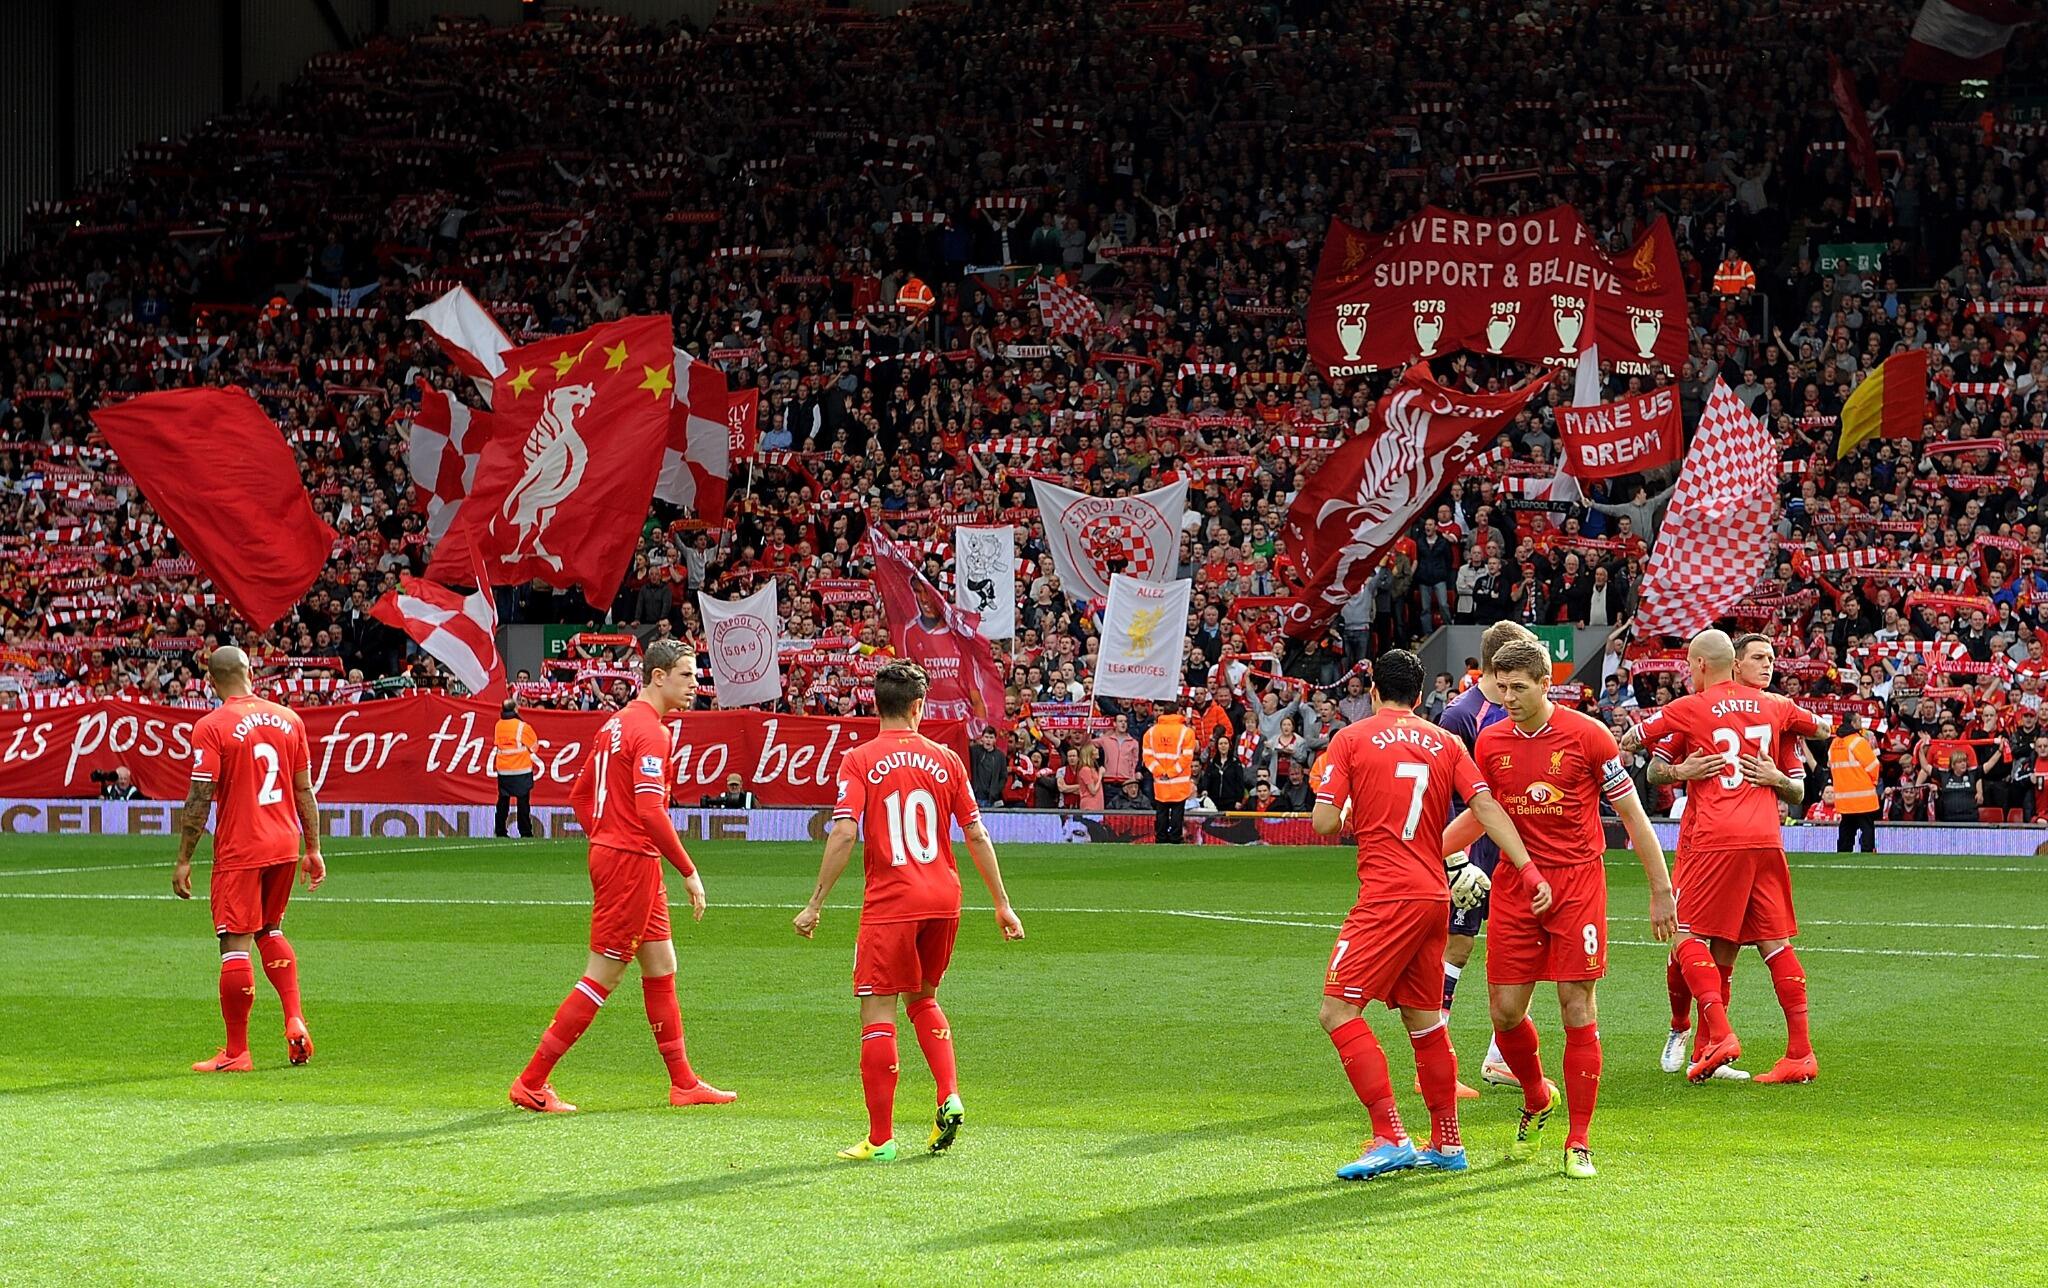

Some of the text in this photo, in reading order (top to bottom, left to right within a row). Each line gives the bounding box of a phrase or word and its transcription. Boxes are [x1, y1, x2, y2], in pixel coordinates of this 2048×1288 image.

[1374, 257, 1623, 296] SUPPORT & BELIEVE
[1335, 302, 1370, 317] 1977
[1411, 299, 1446, 314] 1978
[1490, 301, 1521, 315] 1981
[1550, 293, 1586, 310] 1984
[1329, 364, 1378, 378] ROME
[1615, 360, 1675, 379] ISTANL
[1564, 390, 1673, 435] MAKE US
[1582, 429, 1662, 467] DREAM
[1510, 500, 1567, 512] LIVERPOOL F.C.
[941, 513, 978, 525] SHANKLY
[64, 577, 108, 590] JUSTICE
[1136, 587, 1165, 599] ALLEZ
[715, 616, 753, 644] LIVERPOOL
[157, 640, 187, 648] LIVERPOOL
[797, 654, 815, 662] WALK
[828, 654, 844, 662] WALK
[924, 657, 960, 668] crown
[1107, 663, 1126, 674] LES
[1638, 661, 1676, 670] LIVERPOOL
[1940, 662, 1962, 673] WALK
[1711, 699, 1761, 718] SKRTEL
[1832, 702, 1851, 712] WALK
[231, 712, 293, 743] JOHNSON
[1053, 717, 1070, 727] THIS
[1071, 717, 1081, 727] IS
[2, 712, 52, 764] is
[63, 709, 193, 788] poss
[311, 709, 409, 796] for
[668, 718, 729, 786] ho
[1371, 727, 1444, 758] SUAREZ
[1711, 723, 1773, 790] 37
[253, 742, 283, 807] 2
[867, 751, 949, 785] COUTINHO
[1394, 761, 1430, 841] 7
[1508, 804, 1564, 816] is Believing
[884, 788, 939, 868] 10
[1581, 923, 1599, 956] 8
[1330, 939, 1350, 972] 7
